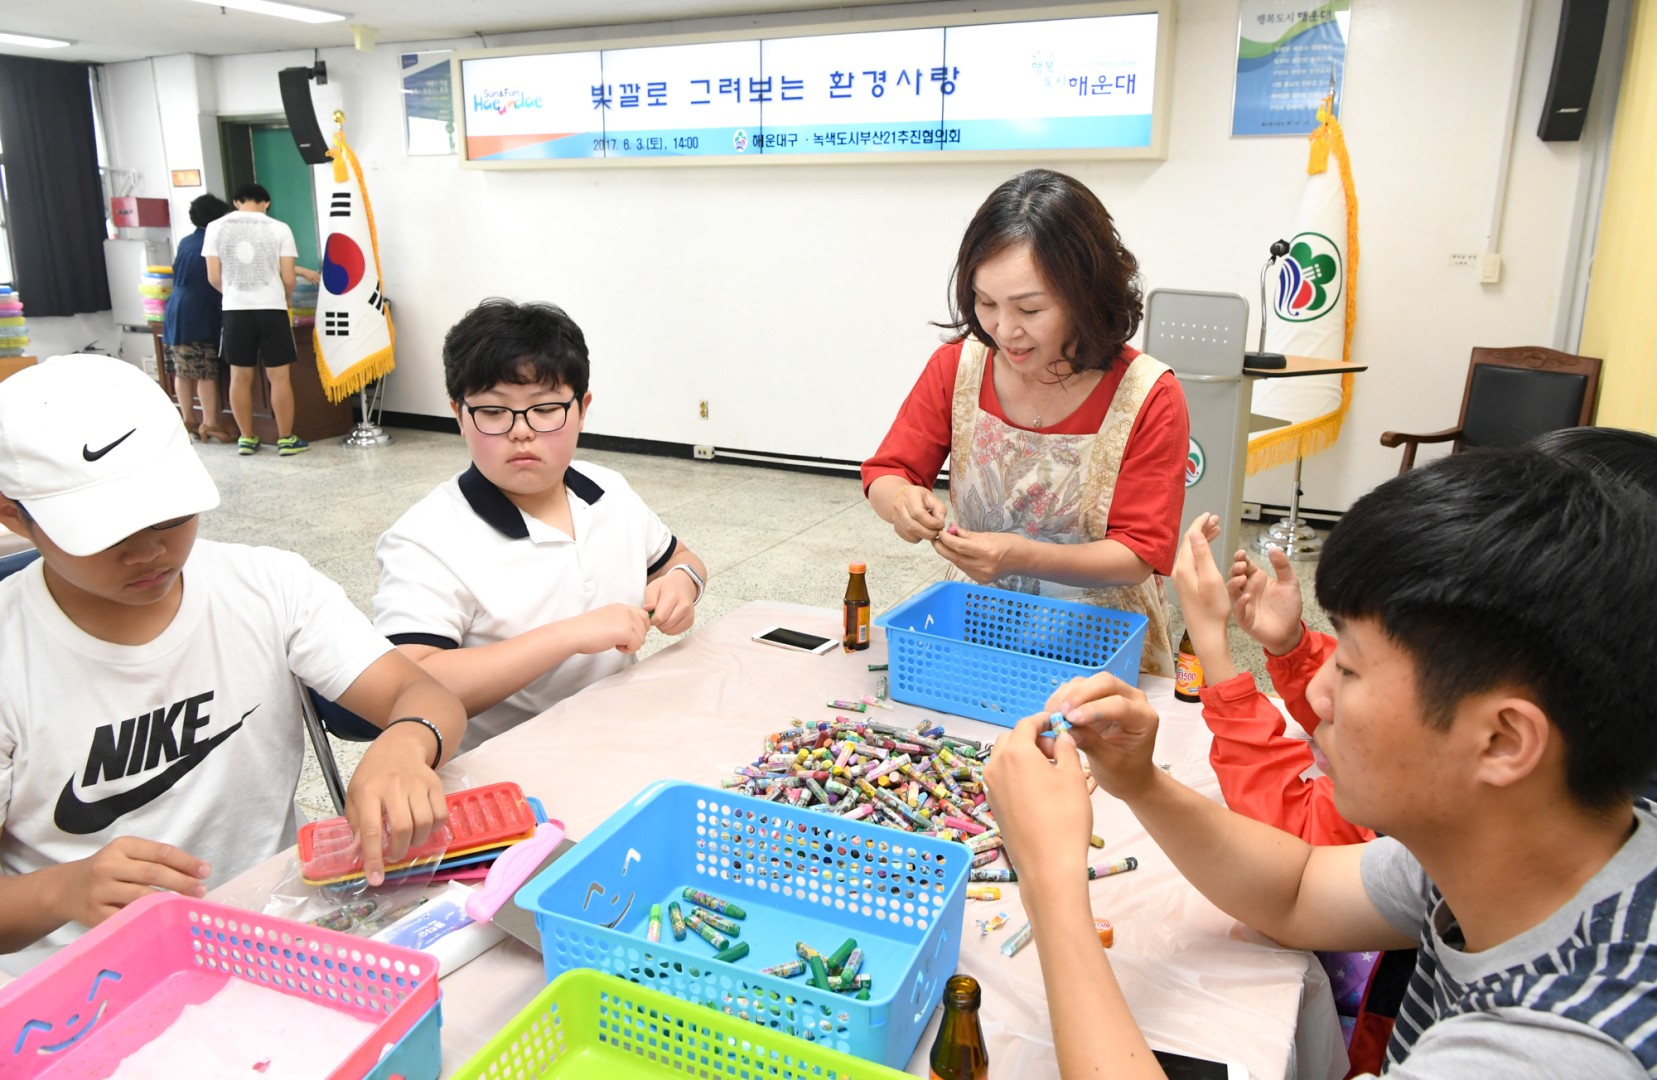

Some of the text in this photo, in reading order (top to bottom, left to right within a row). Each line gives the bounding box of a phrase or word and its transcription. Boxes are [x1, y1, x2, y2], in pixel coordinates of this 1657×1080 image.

[591, 66, 960, 111] 빛깔로 그려보는 환경사랑
[1068, 73, 1137, 97] 해운대
[673, 136, 699, 150] 14:00
[752, 133, 799, 149] 해운대구
[81, 689, 215, 788] NIKE
